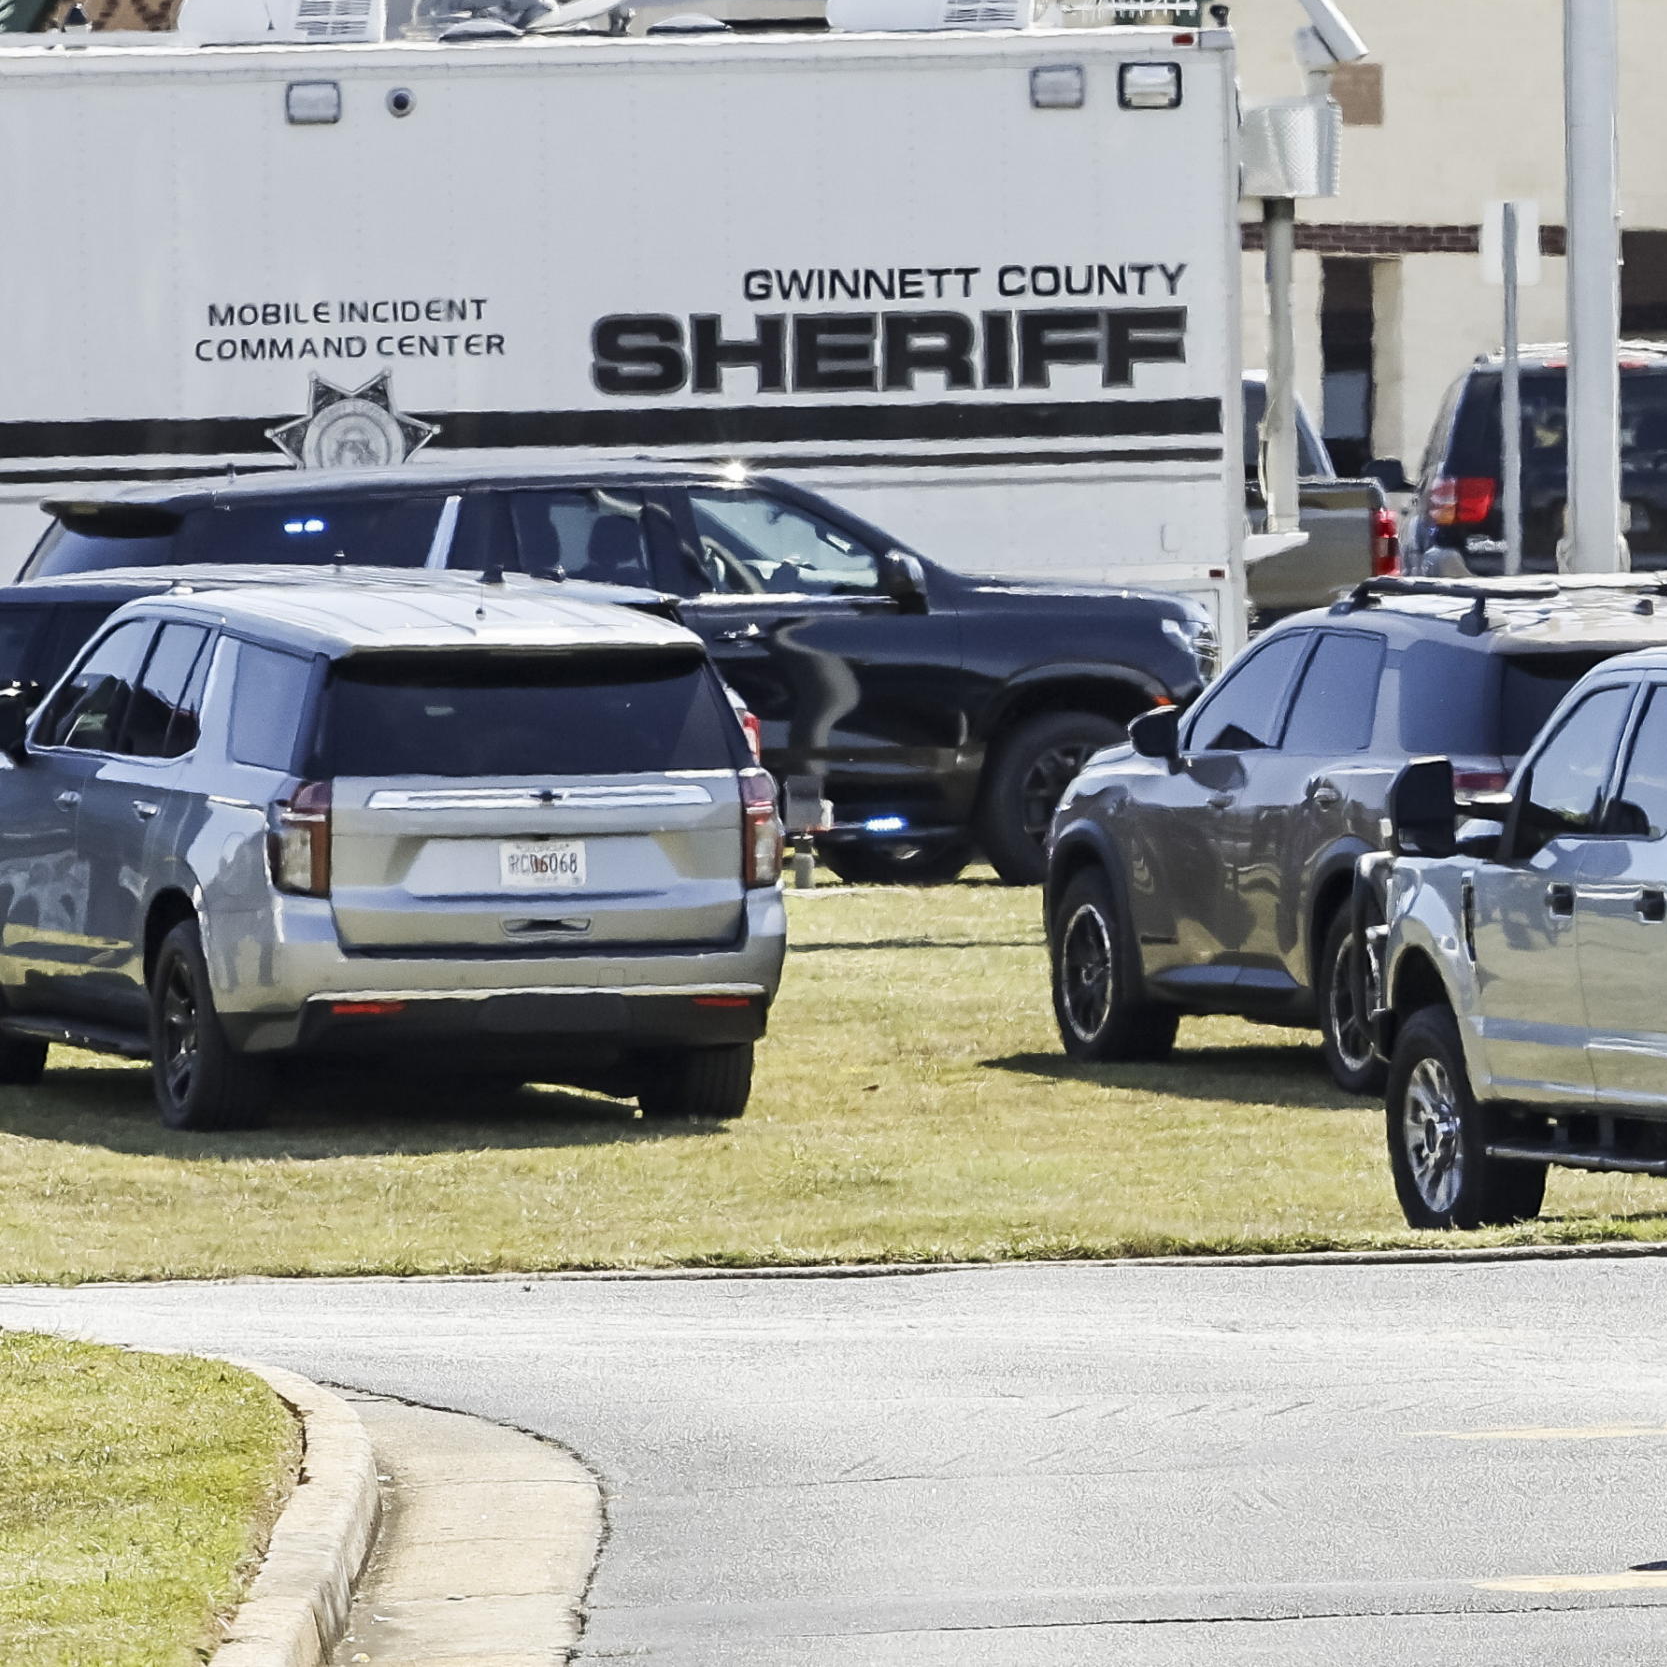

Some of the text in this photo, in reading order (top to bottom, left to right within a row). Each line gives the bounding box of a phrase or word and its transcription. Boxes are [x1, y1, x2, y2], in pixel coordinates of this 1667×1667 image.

[743, 262, 1188, 302] GWINNETT COUNTY
[208, 297, 488, 327] MOBILE INCIDENT
[194, 332, 506, 363] COMMAND CENTER
[591, 306, 1188, 397] SHERIFF
